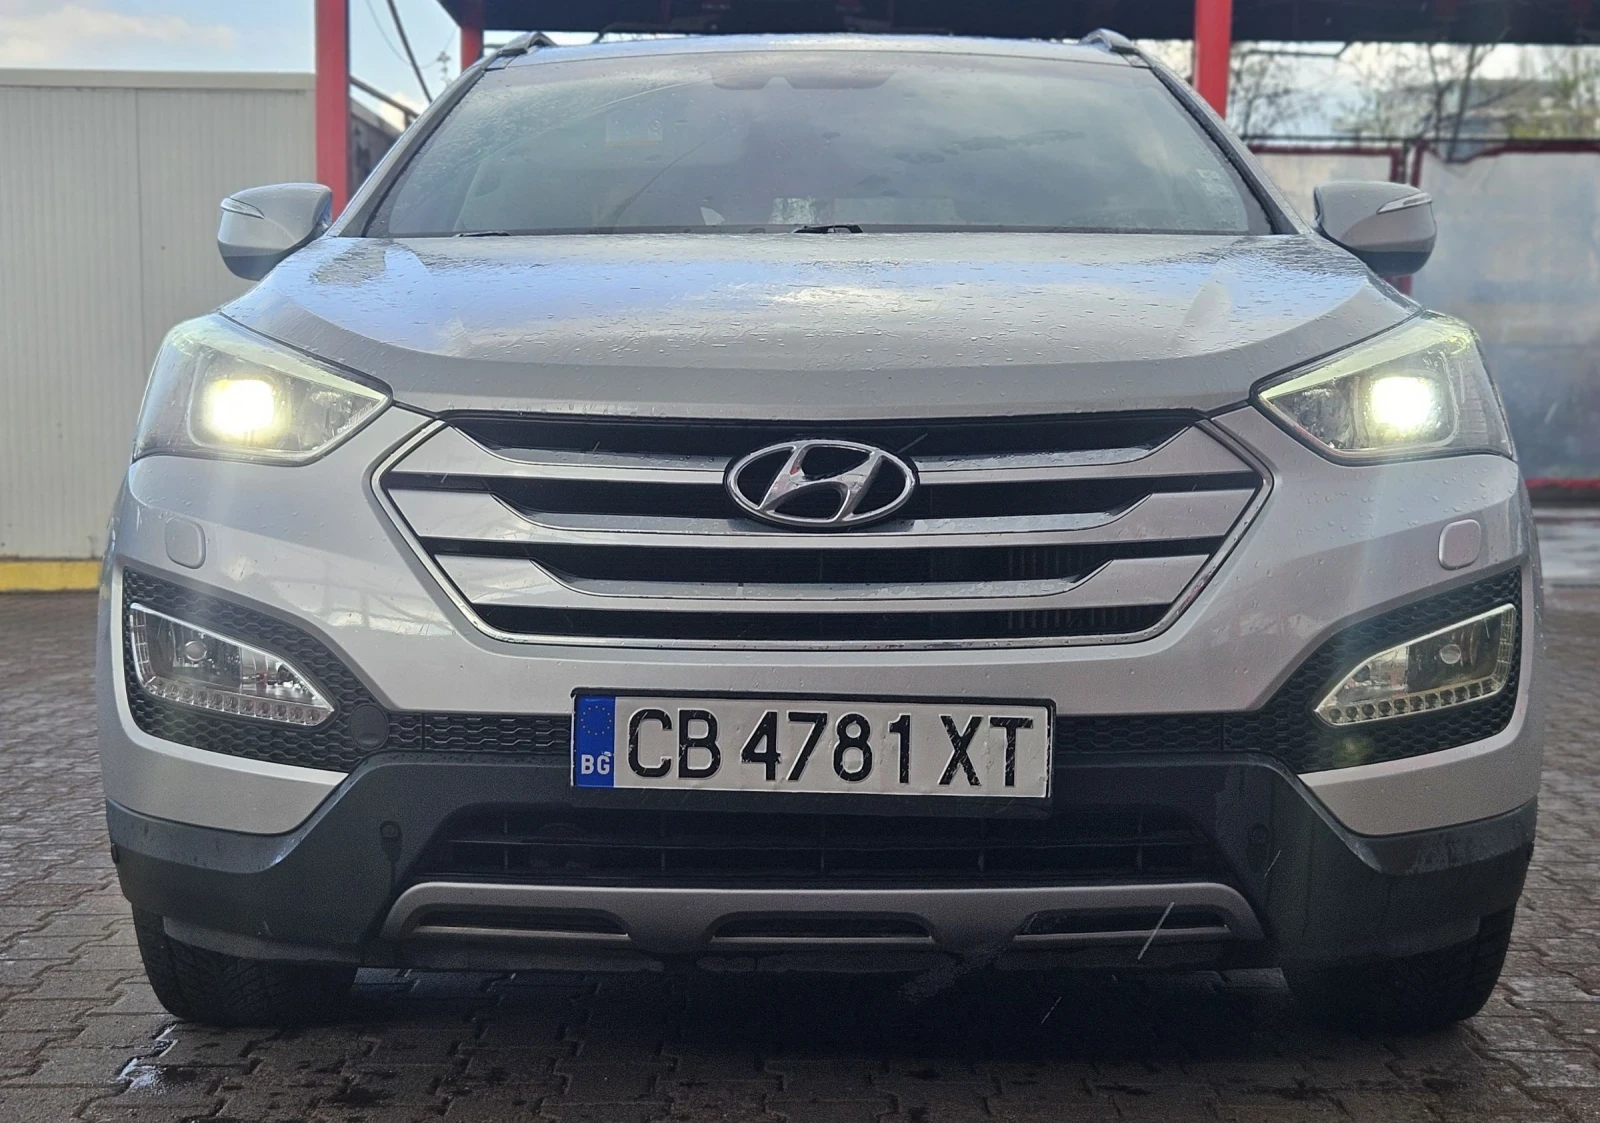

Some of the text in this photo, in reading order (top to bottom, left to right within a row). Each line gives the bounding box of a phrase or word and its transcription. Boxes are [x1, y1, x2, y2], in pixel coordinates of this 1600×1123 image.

[580, 756, 611, 775] BG
[627, 708, 1033, 787] CB 4781 XT
